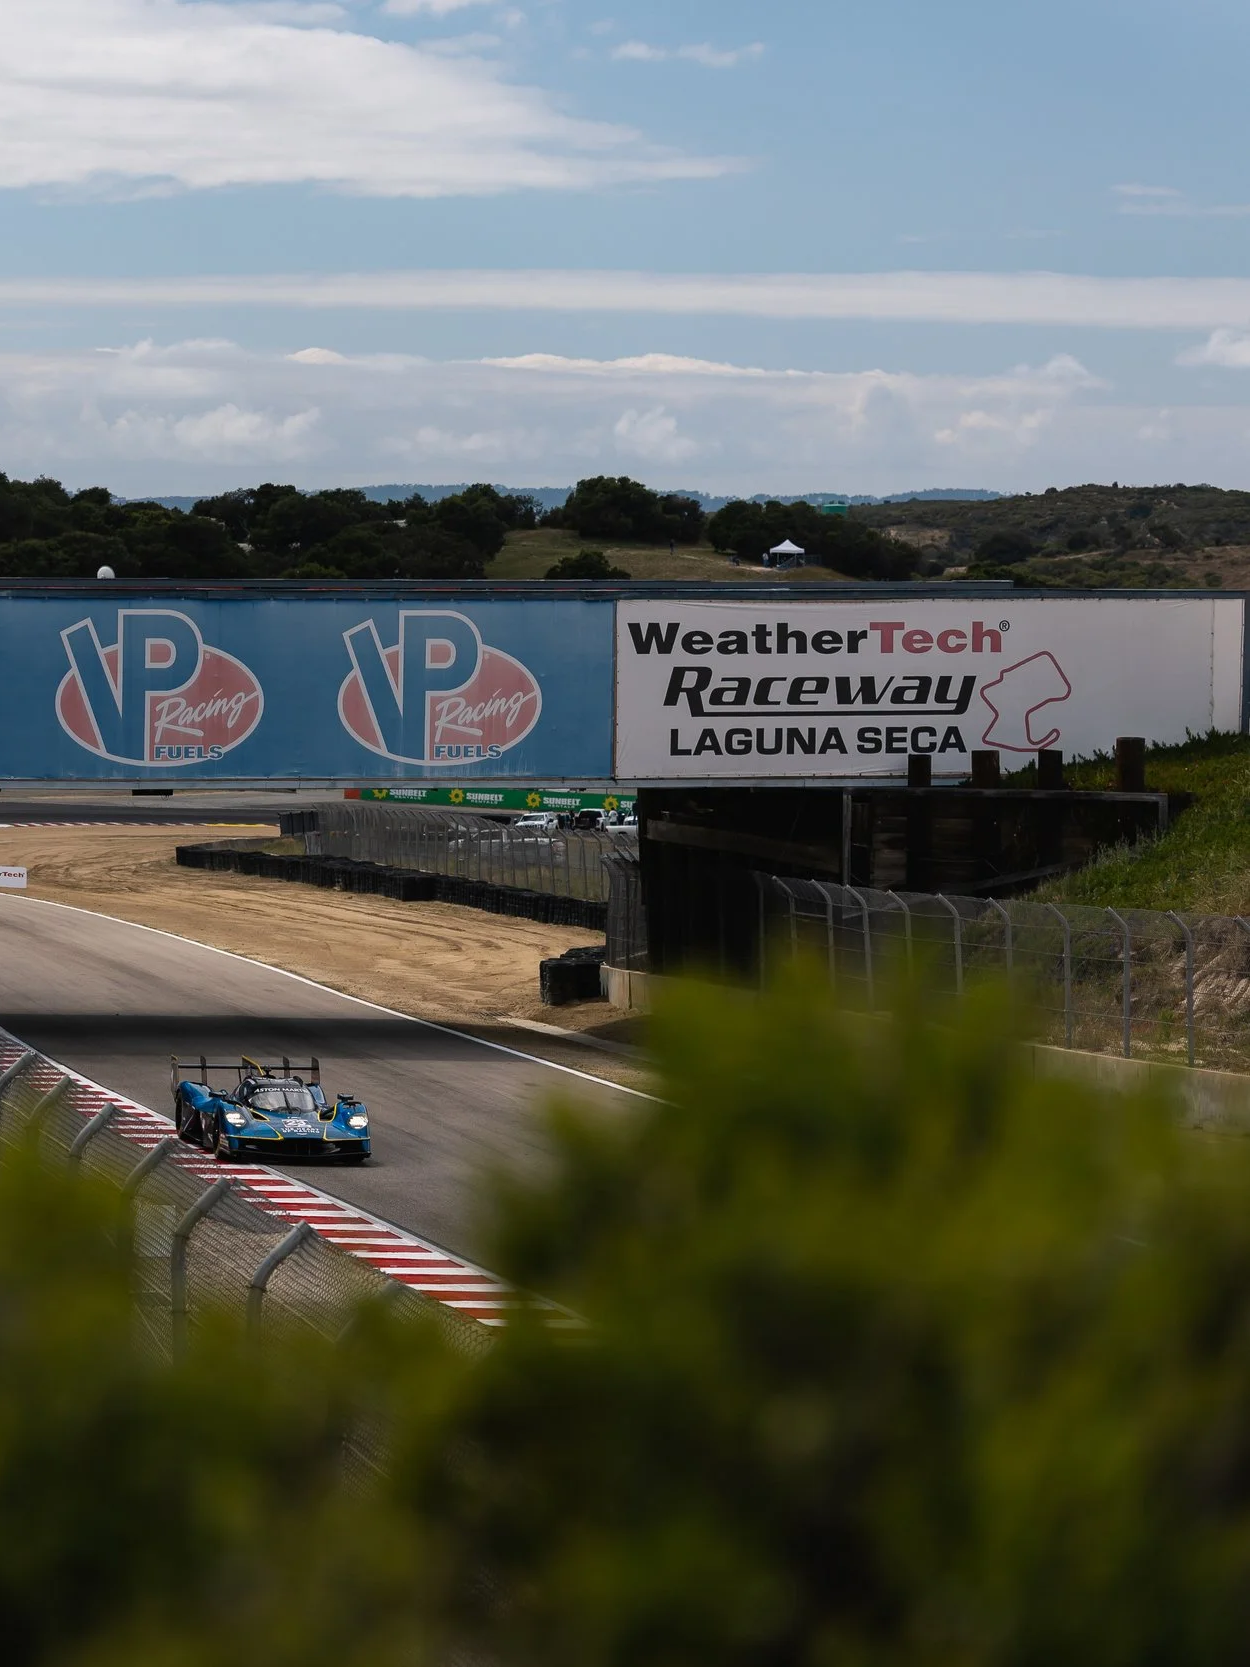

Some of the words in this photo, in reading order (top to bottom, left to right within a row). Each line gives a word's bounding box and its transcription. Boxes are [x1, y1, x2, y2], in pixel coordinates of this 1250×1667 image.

[60, 608, 203, 766] VP
[341, 609, 483, 766] VP
[662, 666, 977, 718] Raceway
[154, 688, 260, 743] Racing
[434, 687, 537, 743] Racing
[154, 744, 224, 760] FUELS
[434, 744, 503, 760] FUELS
[669, 727, 848, 756] LAGUNA
[856, 726, 967, 754] SECA
[389, 788, 427, 797] SUNBELT
[466, 792, 504, 801] SUNBELT
[543, 797, 581, 806] SUNBELT
